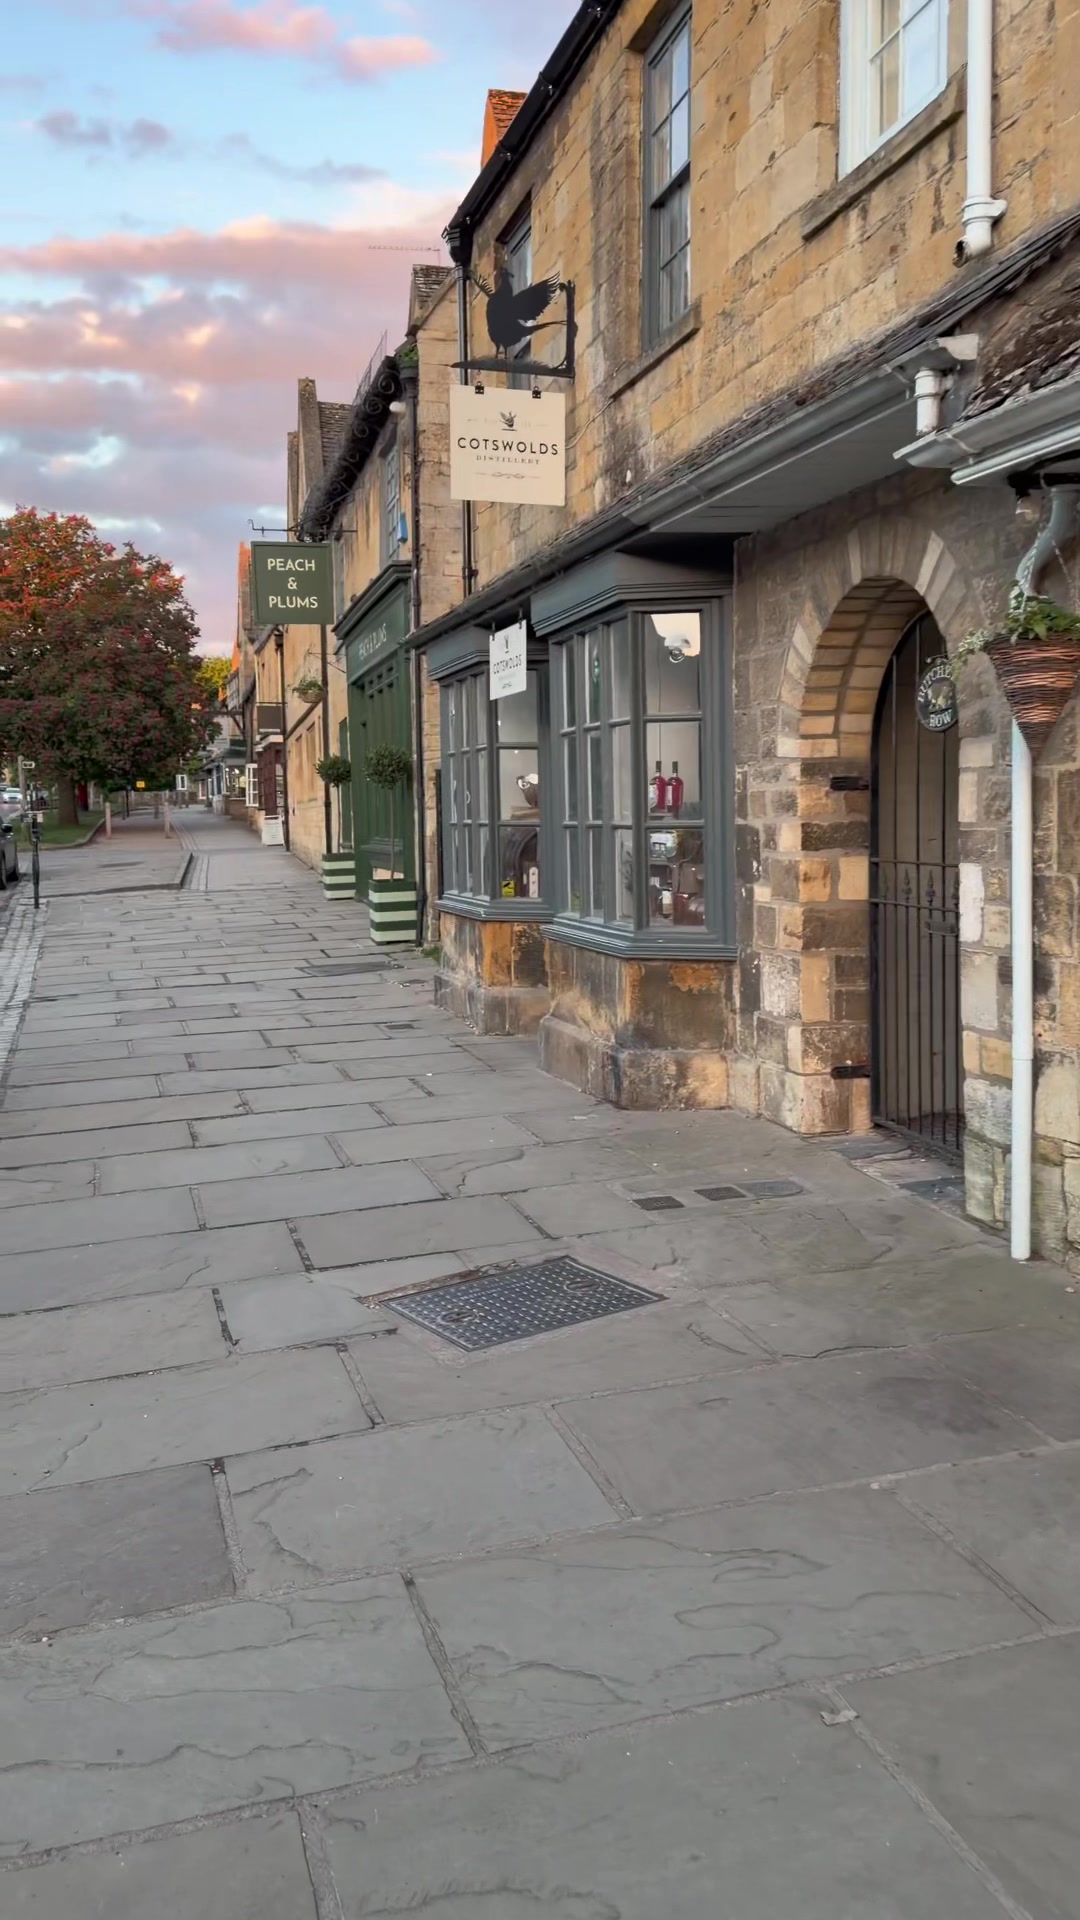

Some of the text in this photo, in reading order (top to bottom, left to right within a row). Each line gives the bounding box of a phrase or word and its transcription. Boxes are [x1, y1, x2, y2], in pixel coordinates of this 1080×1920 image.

[457, 437, 559, 456] COTSWOLDS
[476, 455, 541, 465] DISTILLERY
[267, 558, 316, 571] PEACH
[287, 577, 298, 590] &
[268, 595, 319, 609] PLUMS
[928, 709, 953, 727] ROW
